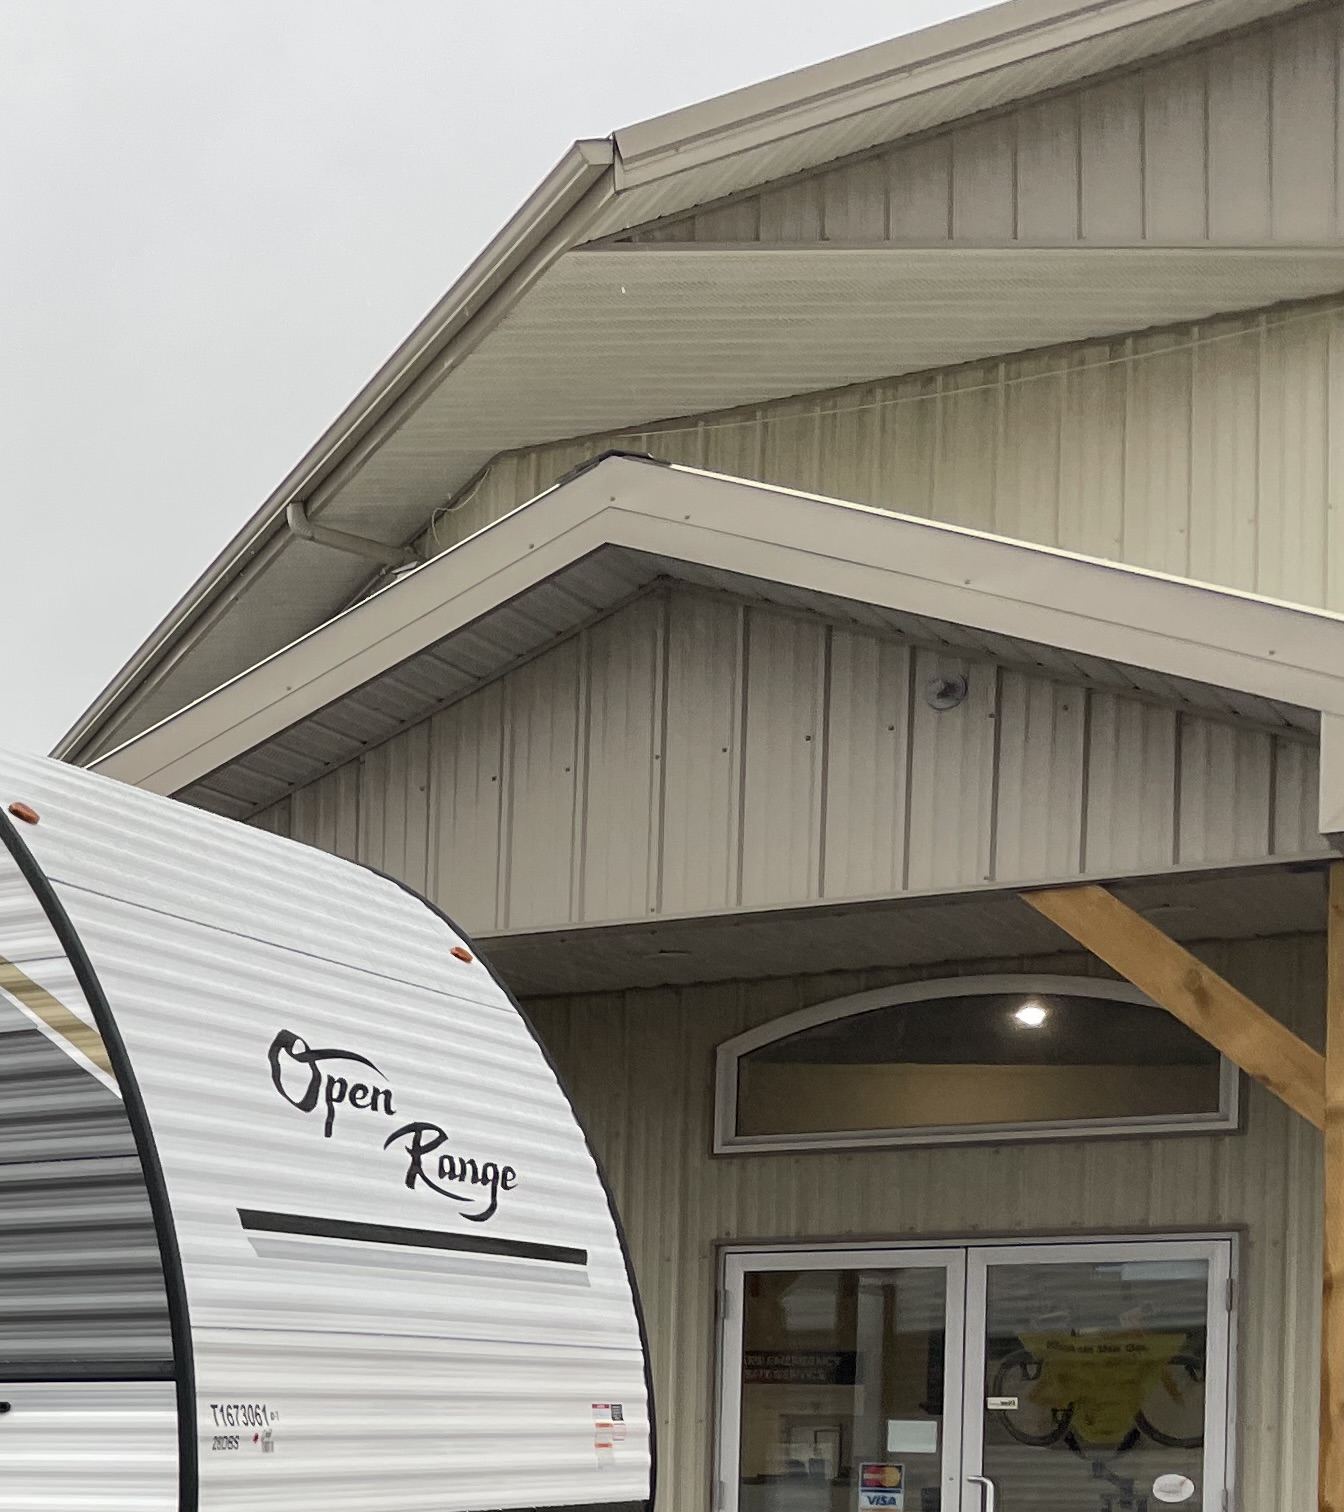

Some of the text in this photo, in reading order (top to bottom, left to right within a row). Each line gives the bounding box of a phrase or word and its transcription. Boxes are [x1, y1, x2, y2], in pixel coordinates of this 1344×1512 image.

[268, 1029, 397, 1138] Open
[383, 1121, 518, 1222] Range
[210, 1404, 269, 1427] T1673061
[867, 1495, 897, 1506] VISA
